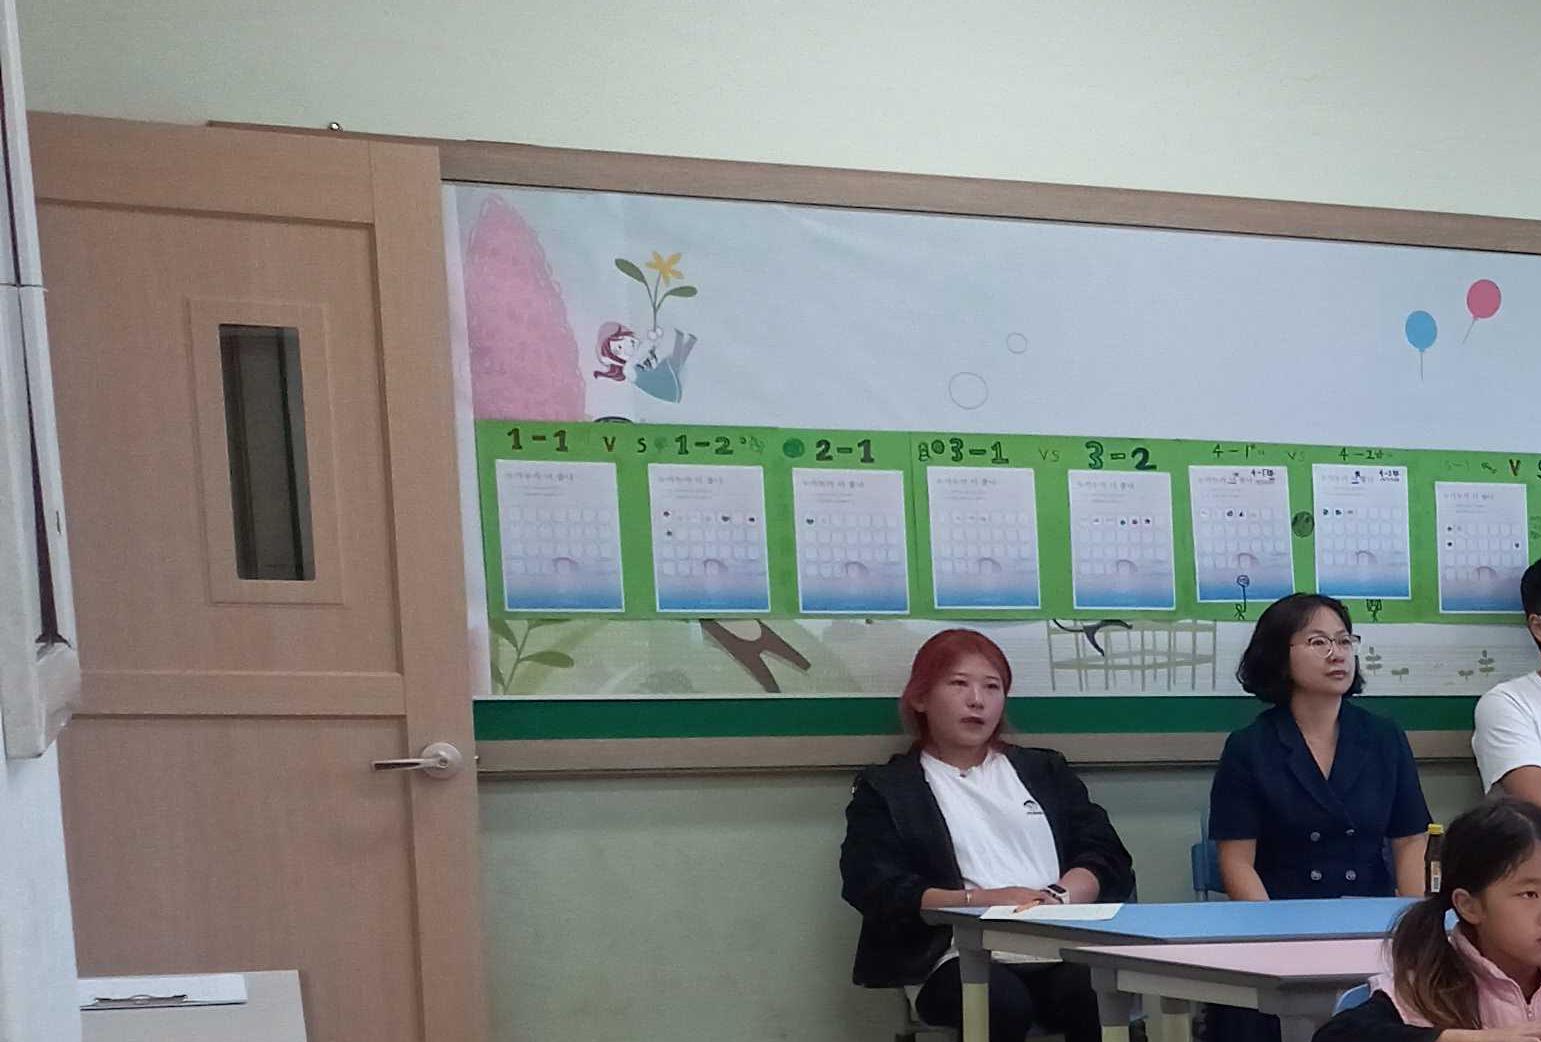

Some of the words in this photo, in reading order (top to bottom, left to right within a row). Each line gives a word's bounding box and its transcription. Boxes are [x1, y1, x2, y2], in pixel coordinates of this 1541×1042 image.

[507, 427, 568, 452] 1-1
[675, 434, 733, 455] 1-2
[815, 439, 874, 463] 2-1
[949, 438, 1009, 464] 3-1
[1085, 440, 1157, 470] 3-2
